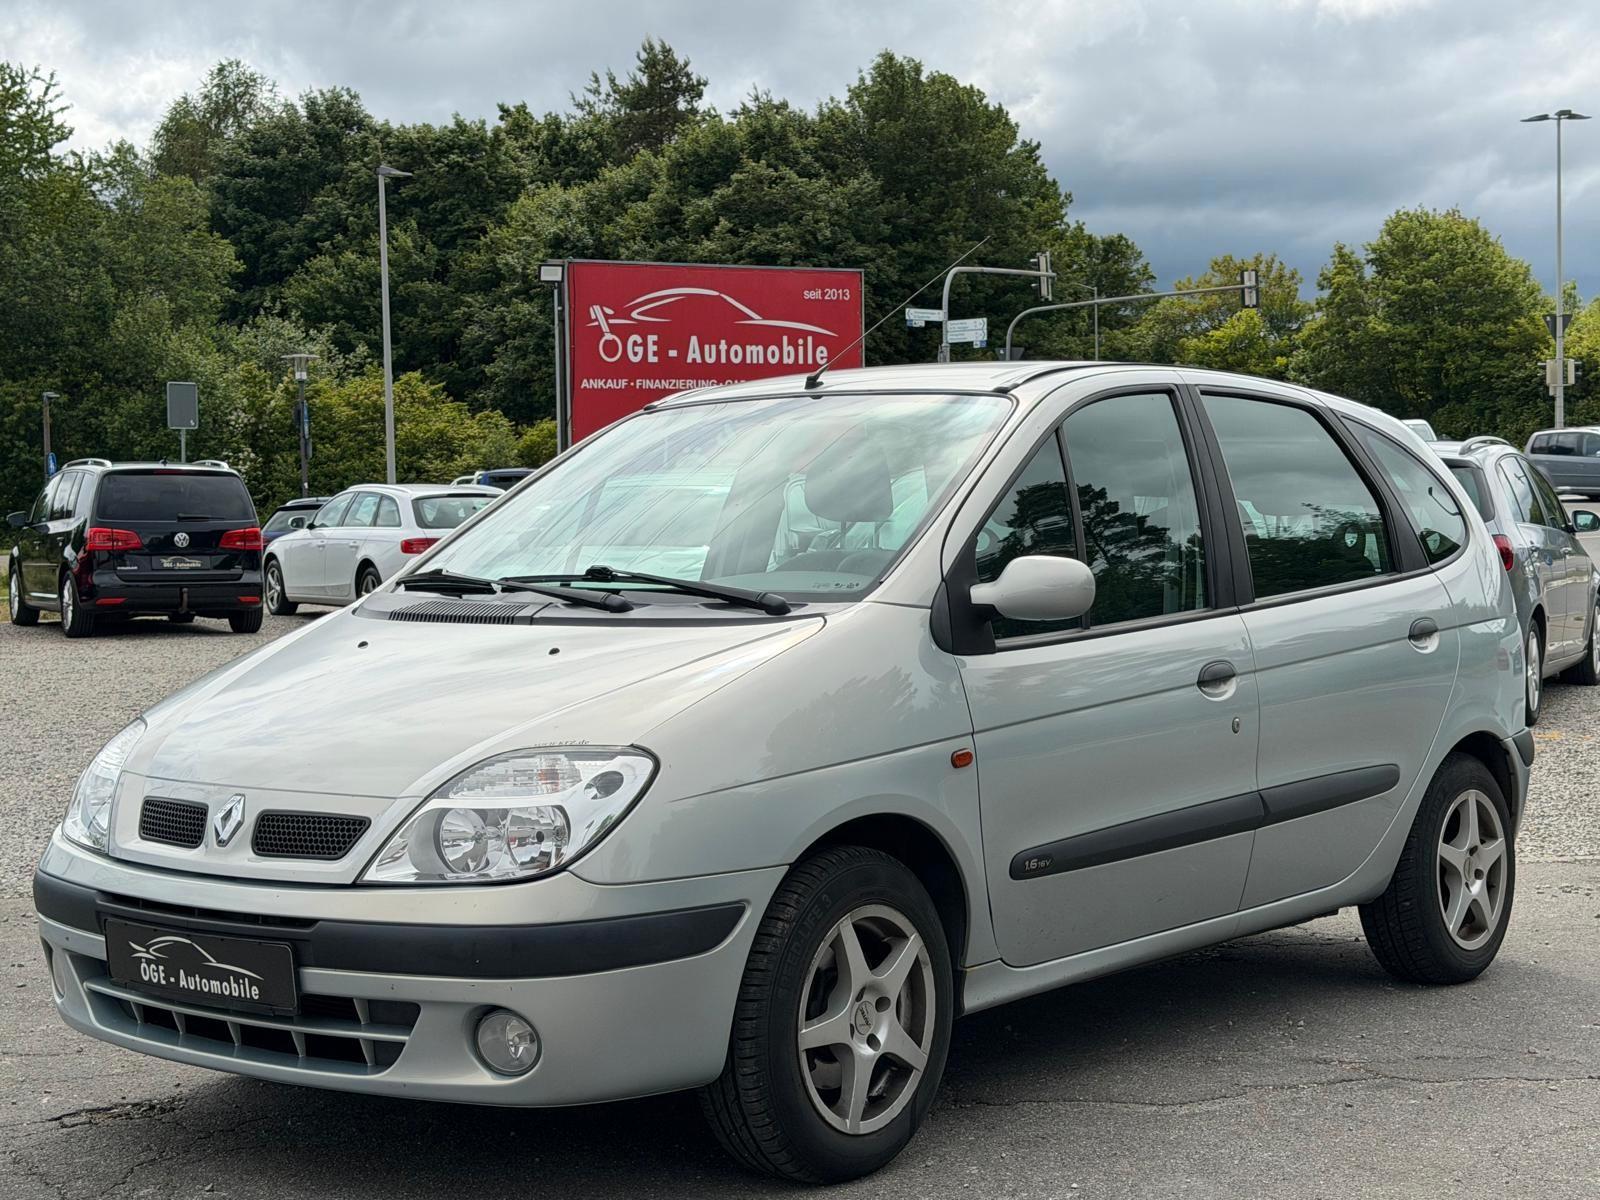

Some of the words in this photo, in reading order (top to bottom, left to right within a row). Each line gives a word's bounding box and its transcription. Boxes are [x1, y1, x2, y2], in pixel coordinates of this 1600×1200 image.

[803, 288, 822, 300] seit
[824, 288, 851, 301] 2013
[686, 335, 829, 366] Automobile
[580, 378, 629, 390] ANKAUF
[635, 379, 717, 391] FINANZIERUNG
[140, 958, 166, 985] ÖGE
[179, 968, 260, 1000] Automobile
